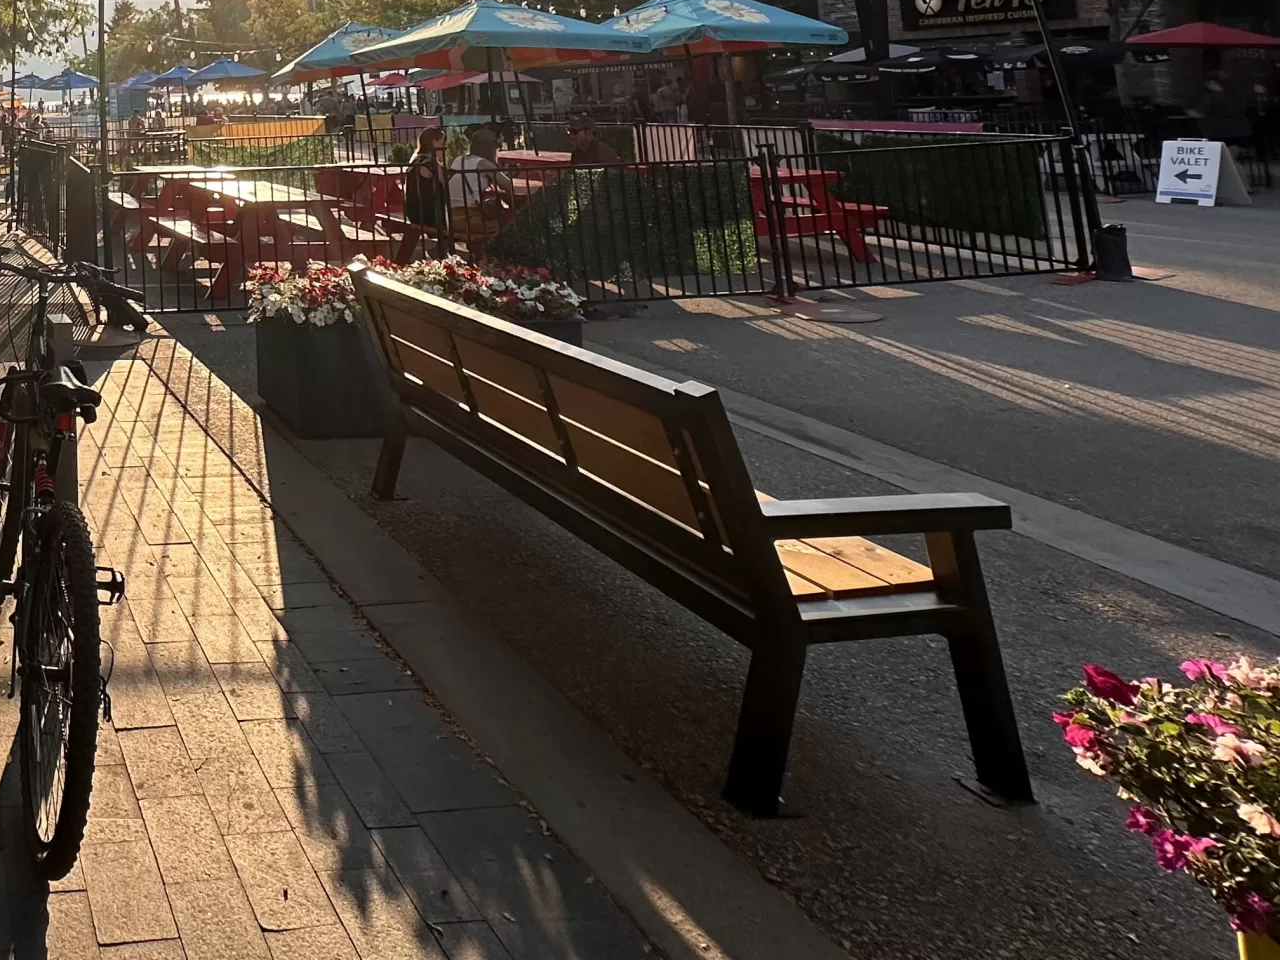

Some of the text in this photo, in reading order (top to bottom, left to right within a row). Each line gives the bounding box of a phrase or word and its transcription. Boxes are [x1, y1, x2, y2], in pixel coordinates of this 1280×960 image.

[919, 10, 1037, 25] CARIBBEAN INSPIRED CUISIN
[1177, 146, 1205, 156] BIKE
[1170, 157, 1211, 167] VALET
